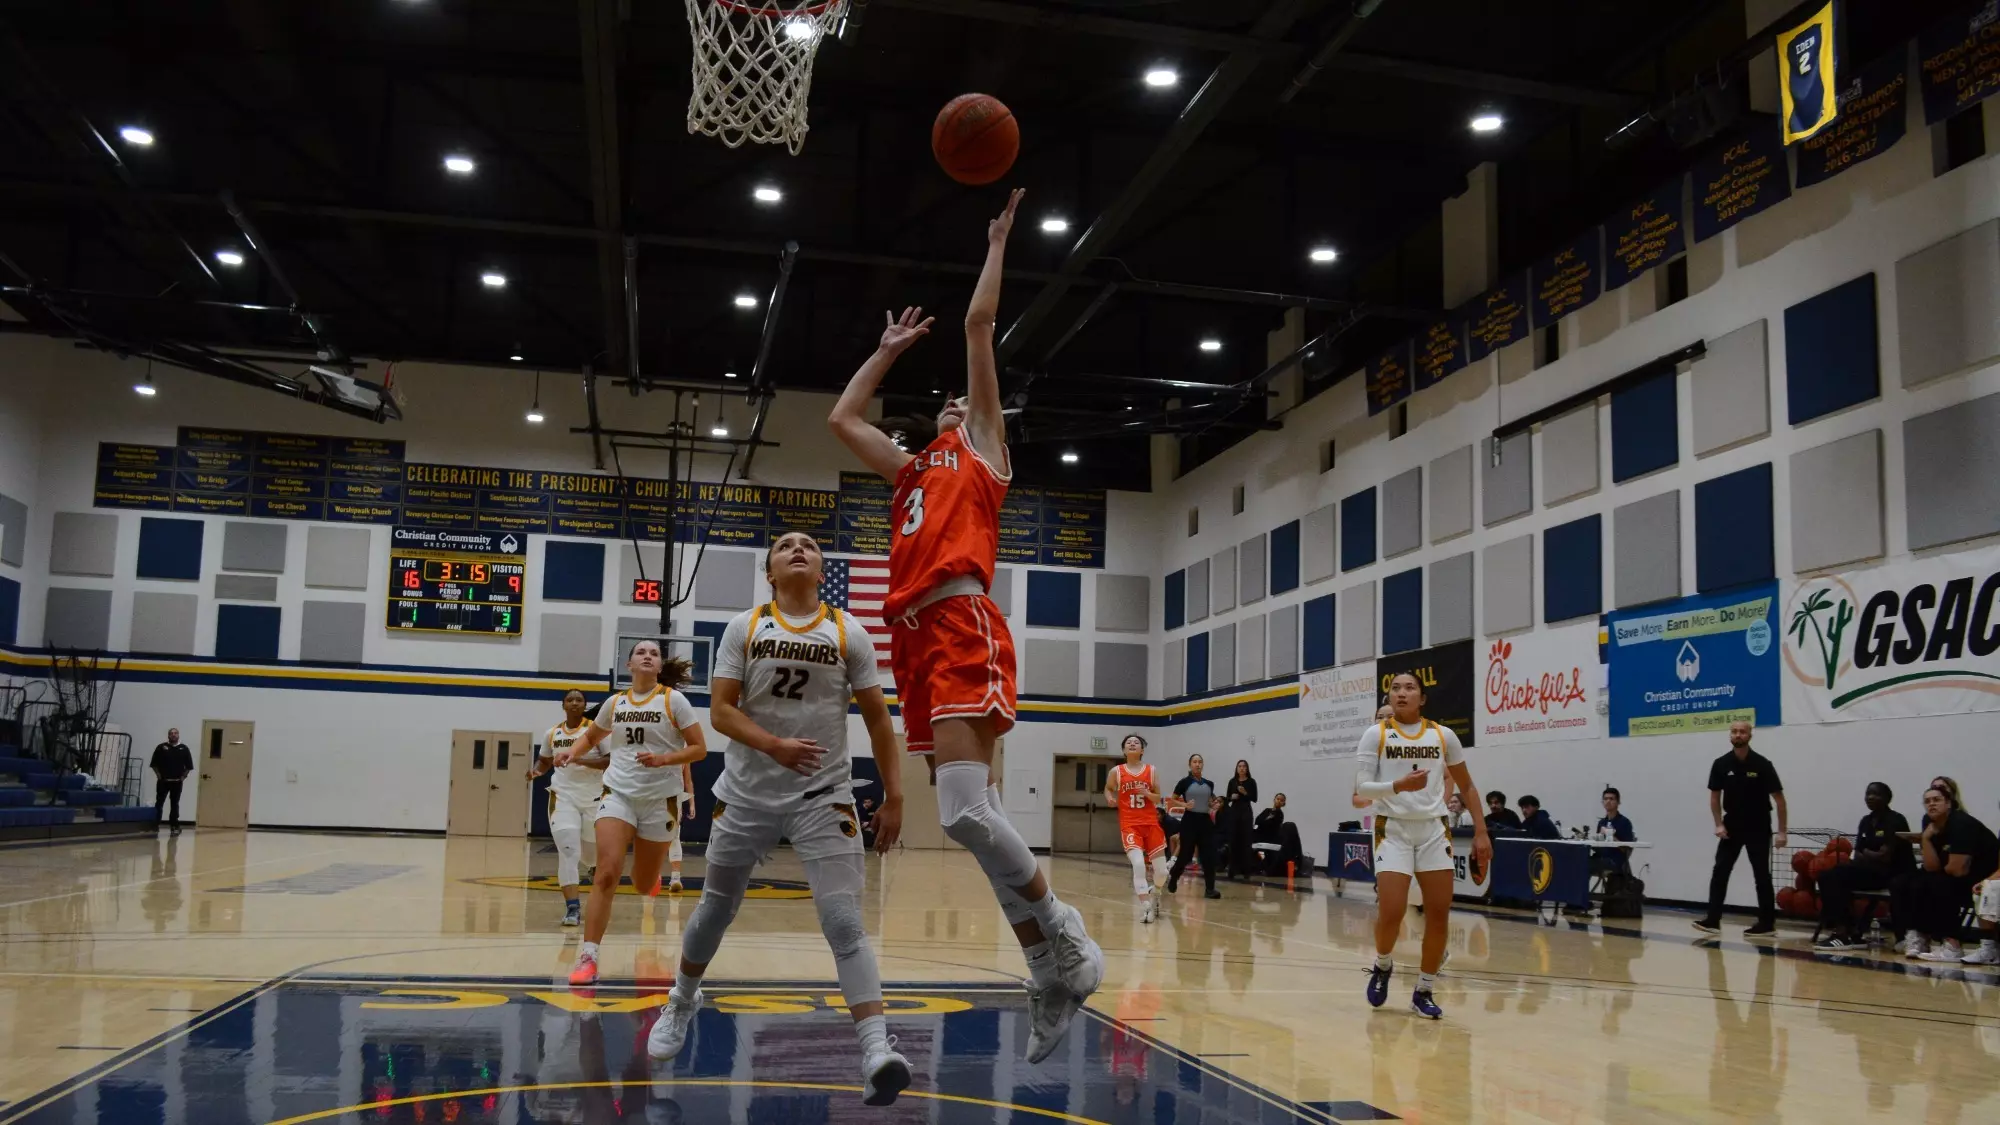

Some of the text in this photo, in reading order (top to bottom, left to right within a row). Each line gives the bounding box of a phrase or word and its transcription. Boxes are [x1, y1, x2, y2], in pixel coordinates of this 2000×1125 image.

[1795, 36, 1815, 55] EDEN
[1798, 52, 1812, 75] 2
[1723, 141, 1750, 164] PCAC
[363, 485, 383, 494] Chapel
[407, 465, 501, 487] CELEBRATING
[508, 471, 533, 489] THE
[540, 474, 628, 496] PRESIDENT'S
[699, 484, 762, 504] NETWORK
[768, 489, 836, 509] PARTNERS
[408, 488, 472, 499] Central Pacific District
[286, 502, 307, 511] Church
[371, 507, 392, 516] Church
[901, 487, 925, 536] 3
[594, 520, 615, 529] Church
[395, 529, 492, 547] Christian Community
[735, 531, 755, 540] Church
[423, 541, 492, 552] CREDIT UNION
[1074, 551, 1093, 560] Church
[399, 559, 417, 568] LIFE
[491, 564, 523, 575] VISITOR
[403, 569, 421, 589] 16
[508, 575, 520, 593] 9
[402, 590, 424, 598] BONUS
[439, 587, 462, 596] PERIOD
[488, 594, 510, 602] BONUS
[635, 580, 660, 601] 26
[398, 600, 418, 609] FOULS
[435, 602, 481, 612] PLAYER FOULS
[492, 605, 512, 614] FOULS
[411, 607, 418, 624] 1
[501, 612, 512, 628] 3
[1617, 626, 1640, 641] Save
[1667, 618, 1689, 633] Earn
[1720, 610, 1735, 623] Do
[1738, 602, 1768, 620] More!
[1854, 571, 2000, 671] GSAC
[750, 639, 839, 666] WARRIORS
[771, 666, 810, 700] 22
[1485, 657, 1587, 715] Chick-fil-A
[1644, 683, 1736, 704] Christian Community
[1661, 701, 1717, 713] CREDIT UNION
[614, 710, 661, 724] WARRIORS
[1485, 716, 1587, 737] Azusa & Glendora Commons
[625, 727, 645, 745] 30
[1385, 746, 1440, 760] WARRIORS
[1129, 794, 1146, 809] 15
